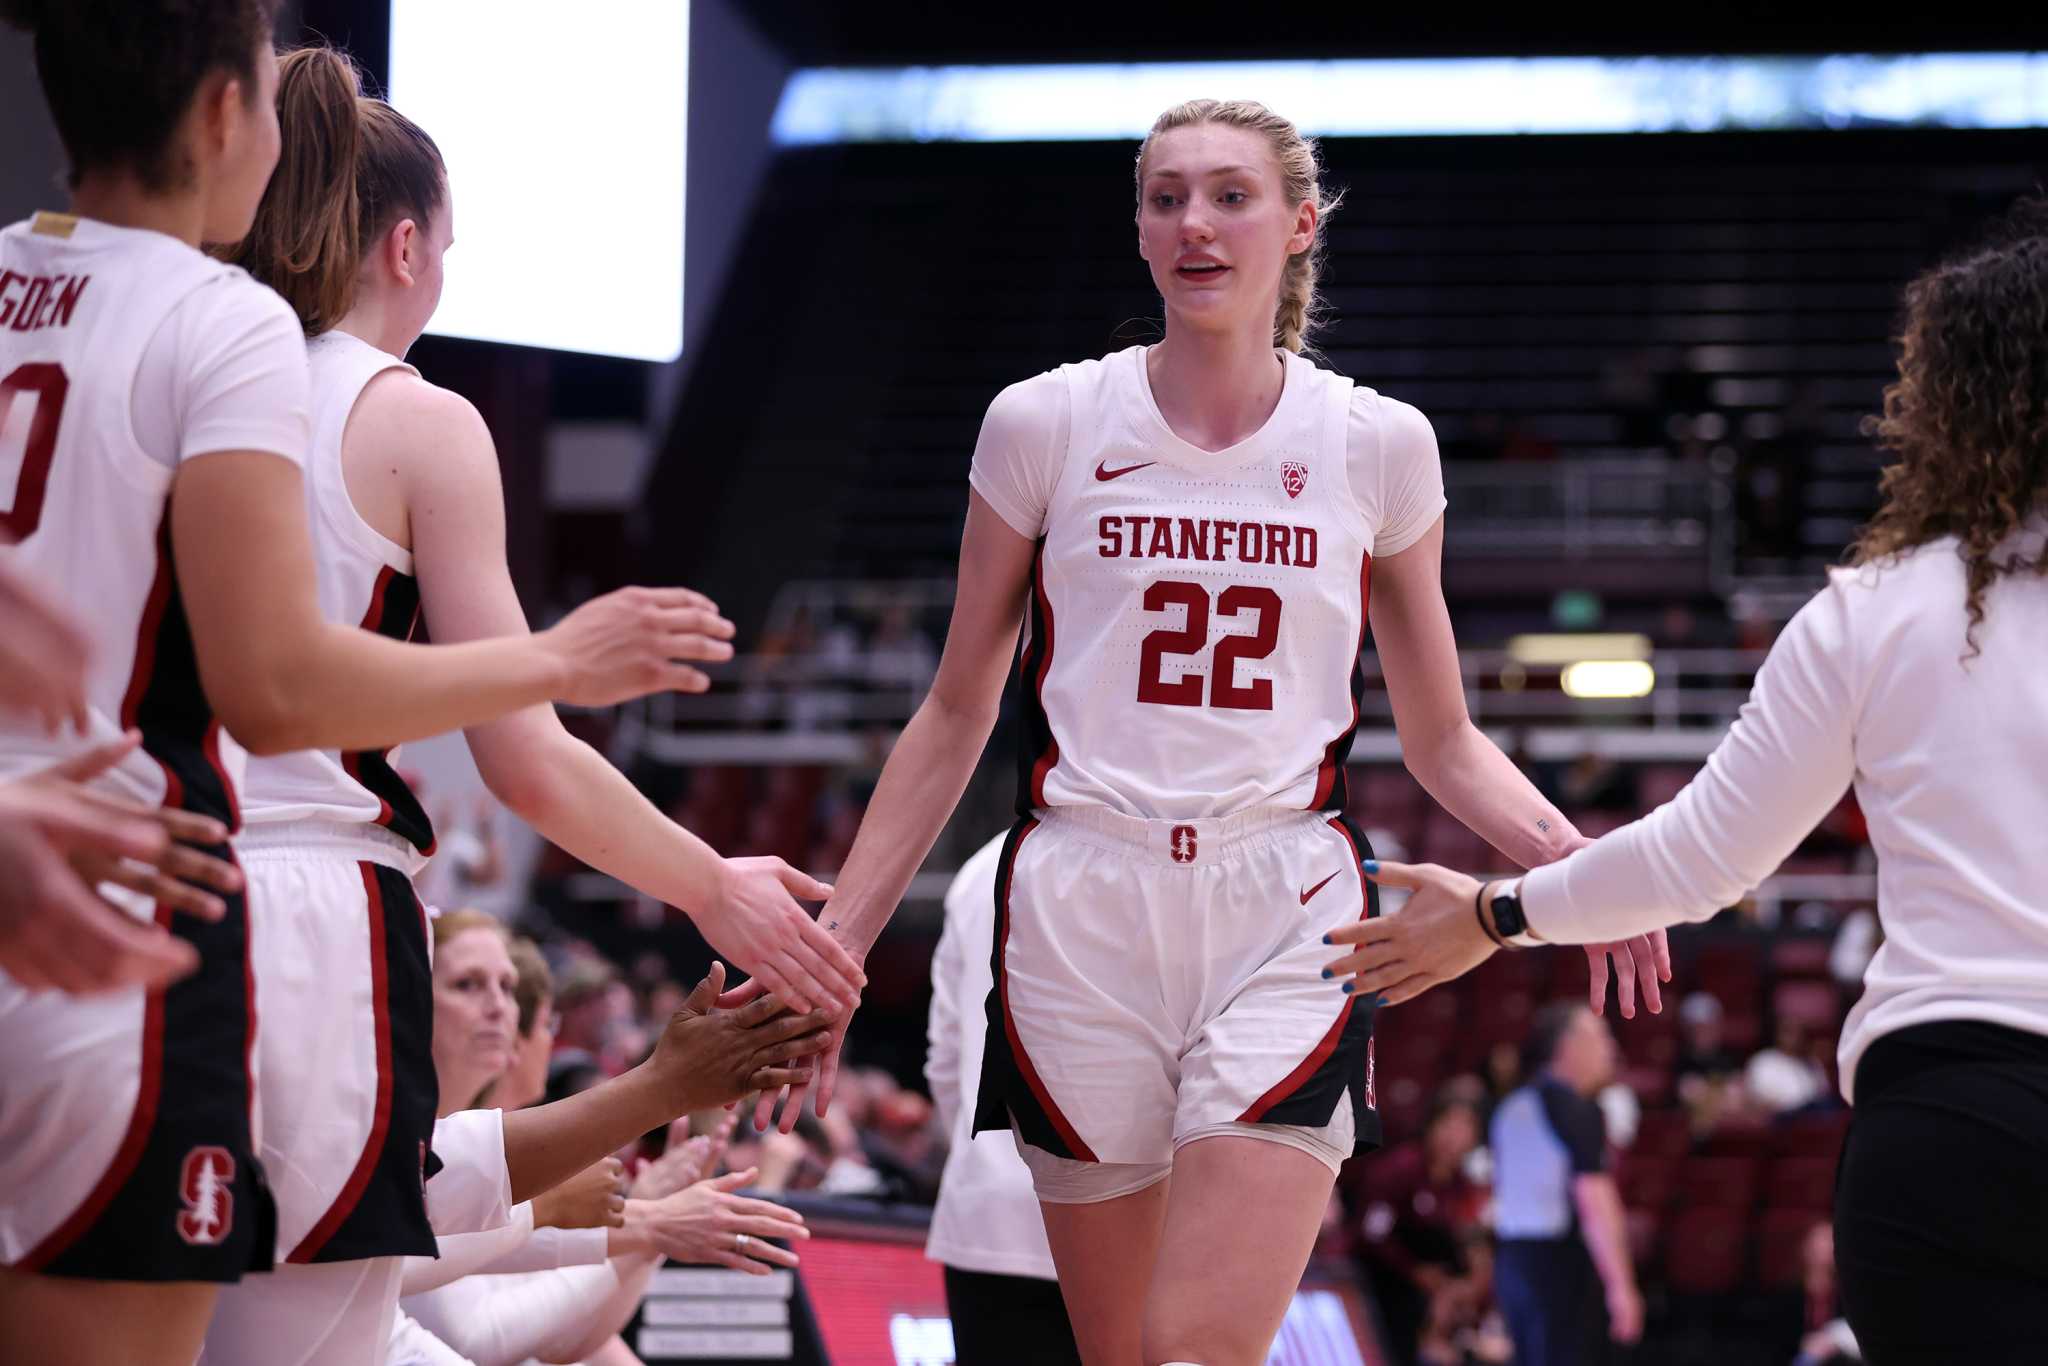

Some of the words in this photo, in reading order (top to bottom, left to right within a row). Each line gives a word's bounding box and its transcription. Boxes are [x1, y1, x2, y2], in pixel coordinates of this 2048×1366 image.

[0, 269, 91, 332] GDEN
[0, 362, 70, 546] 0
[1281, 462, 1308, 485] PAC
[1286, 477, 1301, 492] 12
[1099, 516, 1318, 569] STANFORD
[1137, 580, 1283, 711] 22
